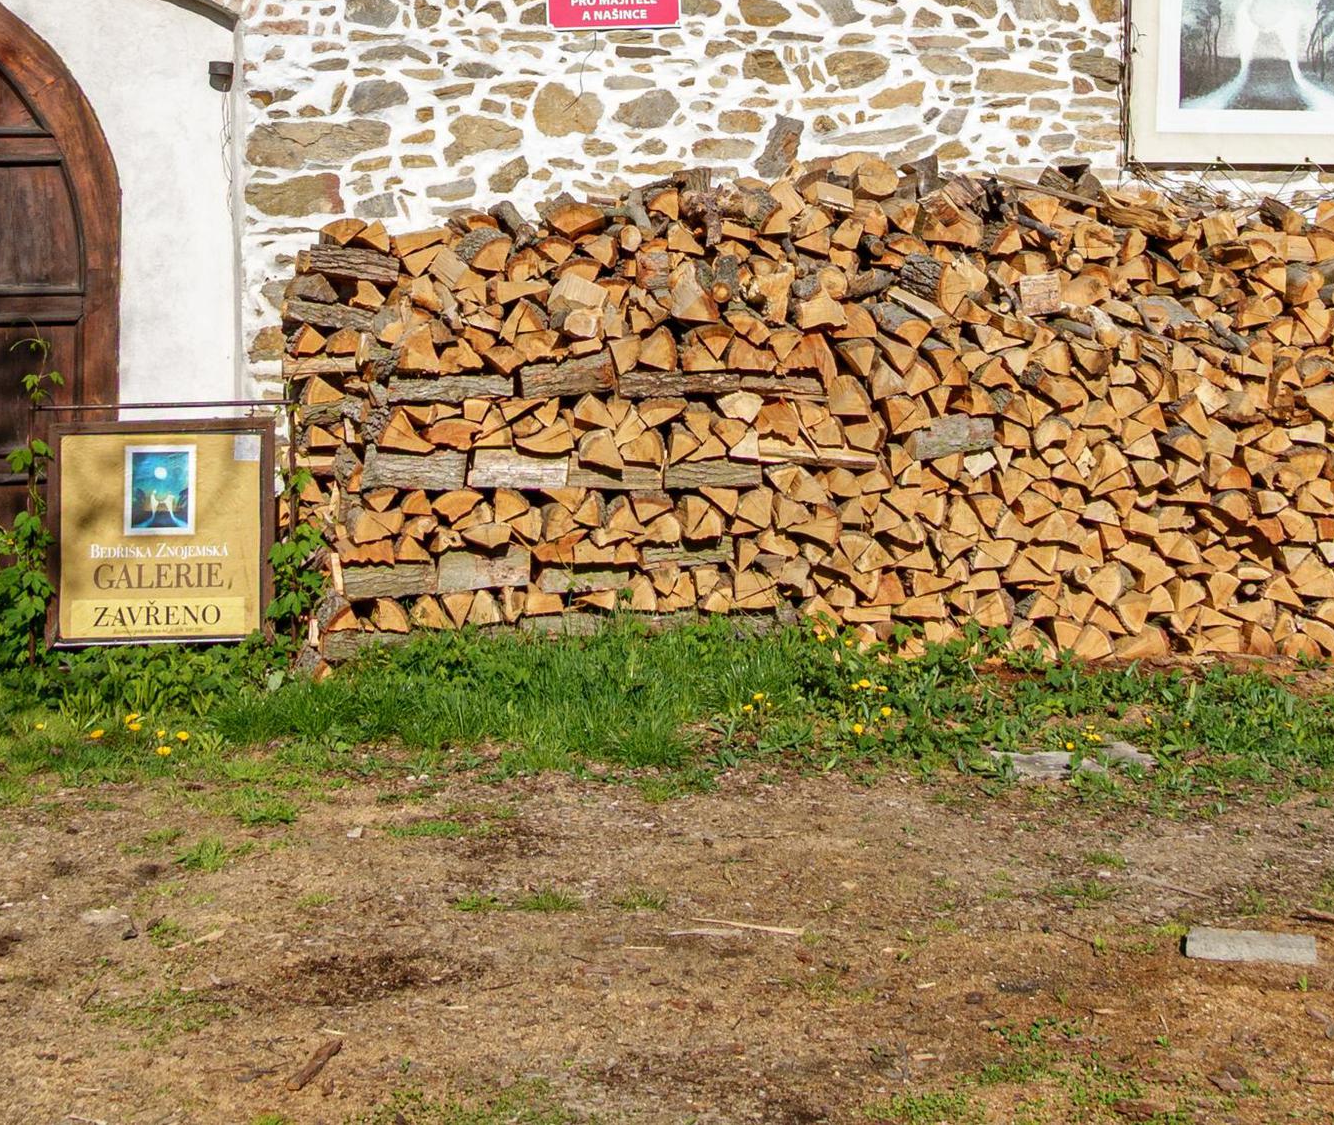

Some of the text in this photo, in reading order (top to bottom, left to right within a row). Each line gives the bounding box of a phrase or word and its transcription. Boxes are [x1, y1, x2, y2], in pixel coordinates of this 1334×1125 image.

[582, 9, 647, 21] A NAŠINCE
[90, 542, 228, 559] BEDŘIŠKA ZNOJEMSKÁ
[93, 562, 224, 590] GALERIE
[93, 600, 221, 627] ZAVŘENO
